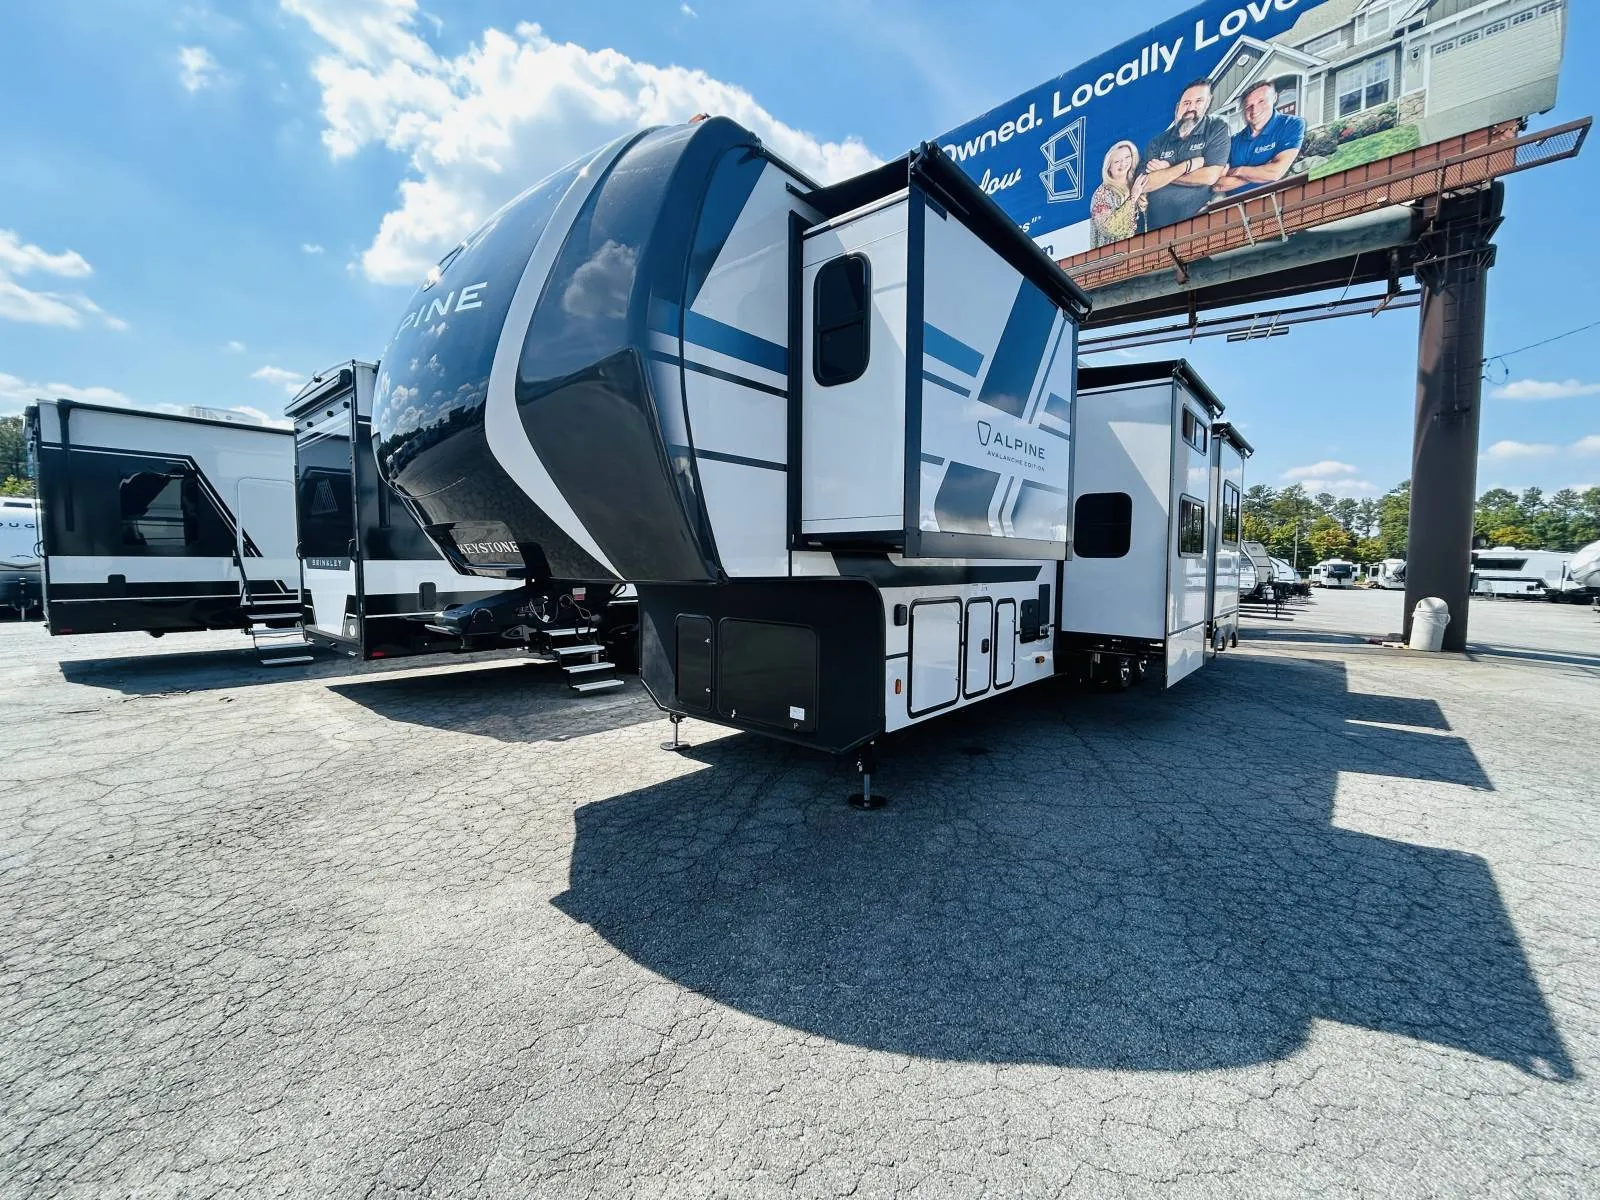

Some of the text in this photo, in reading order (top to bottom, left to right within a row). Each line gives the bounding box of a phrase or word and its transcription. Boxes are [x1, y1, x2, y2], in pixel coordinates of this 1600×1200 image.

[1053, 37, 1184, 119] Locally
[994, 432, 1046, 460] ALPINE
[987, 450, 1045, 472] AVALANCHE EDITION
[456, 541, 520, 554] KEYSTONE
